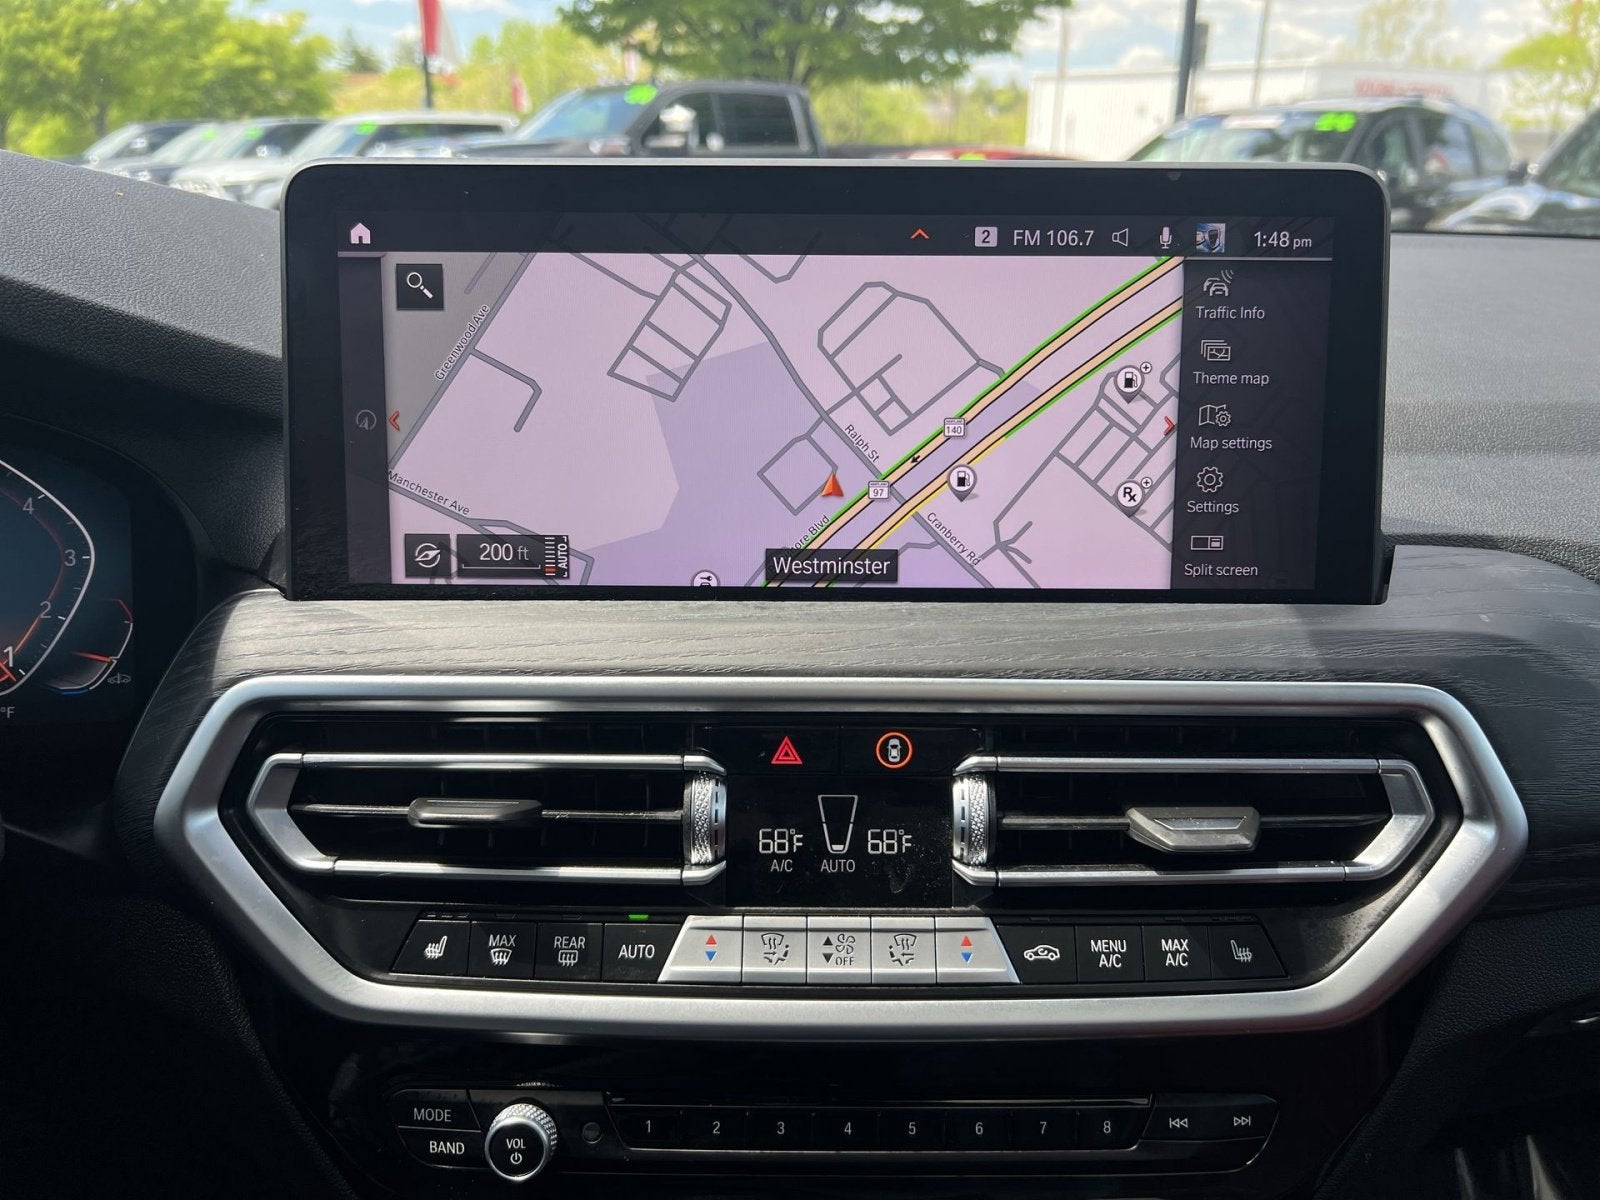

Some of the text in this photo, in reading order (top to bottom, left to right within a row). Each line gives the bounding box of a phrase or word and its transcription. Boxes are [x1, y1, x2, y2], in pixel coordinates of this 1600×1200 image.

[1012, 230, 1095, 246] FM 106.7
[1253, 231, 1312, 249] 1:48 pm
[1195, 305, 1266, 320] Traffic Info
[434, 305, 490, 381] Greenwood Ave
[1193, 370, 1270, 388] Theme map
[946, 426, 962, 435] 140
[844, 424, 870, 453] Ralph
[867, 450, 880, 463] St
[1190, 436, 1273, 451] Map settings
[388, 470, 470, 516] Manchester Ave
[872, 488, 885, 497] 97
[22, 496, 35, 515] 4
[1187, 500, 1240, 514] Settings
[808, 514, 830, 537] Blvd
[927, 512, 982, 567] Cranberry Rd
[64, 549, 76, 567] 3
[479, 543, 529, 562] 200 ft
[557, 543, 568, 570] AUTO
[772, 556, 890, 575] Westminster
[1184, 563, 1259, 578] Split screen
[39, 601, 52, 619] 2
[3, 646, 14, 668] 1
[770, 859, 793, 873] A/C
[820, 859, 856, 873] AUTO
[487, 934, 517, 947] MAX
[553, 936, 586, 950] REAR
[1090, 939, 1127, 953] MENU
[1161, 938, 1189, 952] MAX
[618, 944, 655, 959] AUTO
[835, 956, 855, 966] OFF
[1099, 954, 1122, 968] A/C
[1165, 953, 1189, 967] A/C
[413, 1108, 452, 1123] MODE
[645, 1121, 652, 1133] 1
[712, 1121, 721, 1135] 2
[776, 1121, 785, 1135] 3
[843, 1122, 852, 1136] 4
[908, 1121, 916, 1135] 5
[975, 1122, 983, 1136] 6
[1039, 1121, 1047, 1135] 7
[1102, 1120, 1111, 1134] 8
[429, 1140, 465, 1155] BAND
[506, 1138, 526, 1149] VOL
